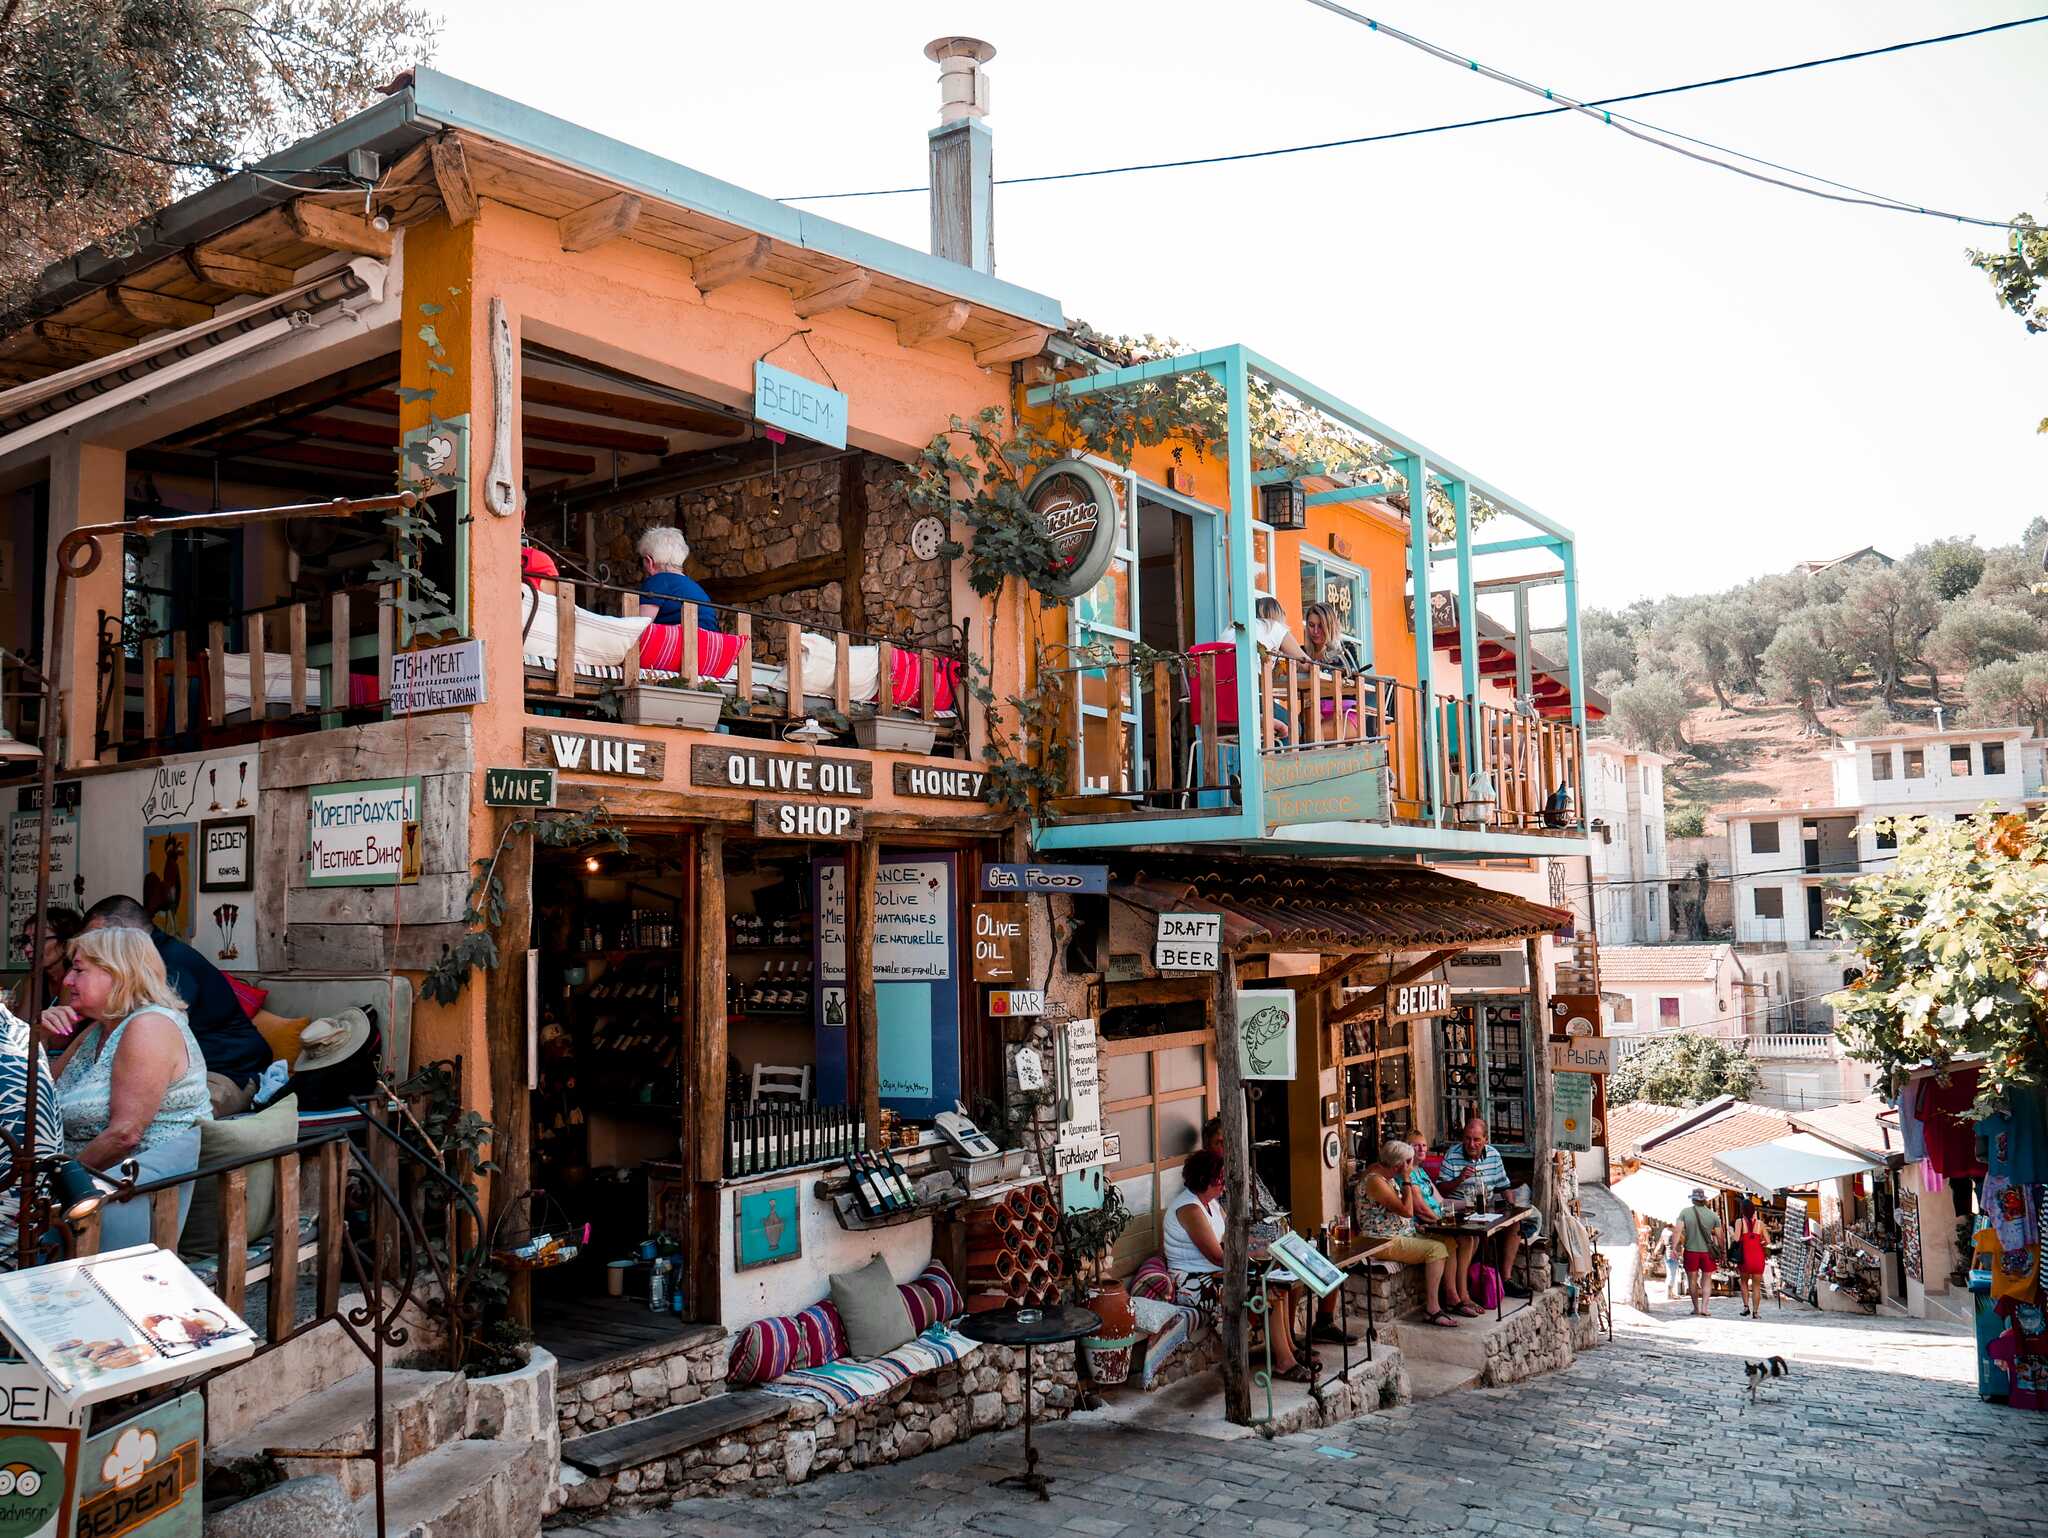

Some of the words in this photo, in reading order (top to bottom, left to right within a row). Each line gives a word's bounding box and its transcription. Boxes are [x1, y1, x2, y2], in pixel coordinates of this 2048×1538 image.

[762, 376, 830, 430] BEDEM
[430, 651, 465, 677] MEAT
[550, 734, 646, 775] WINE
[727, 755, 813, 792] OLIVE
[819, 763, 861, 794] OIL
[911, 768, 984, 797] HONEY
[32, 787, 58, 809] MEU
[160, 788, 179, 811] OIL
[490, 775, 545, 802] WINE
[780, 805, 851, 836] SHOP
[208, 832, 248, 854] BEDEM
[989, 869, 1018, 888] SEA
[1025, 869, 1083, 887] FOOD
[1162, 920, 1218, 937] DRAFT
[1161, 949, 1215, 967] BEER
[1011, 992, 1041, 1013] NAR
[1397, 983, 1447, 1015] BEDEM
[1566, 1048, 1608, 1066] РЫБА
[77, 1472, 174, 1538] BEDEM
